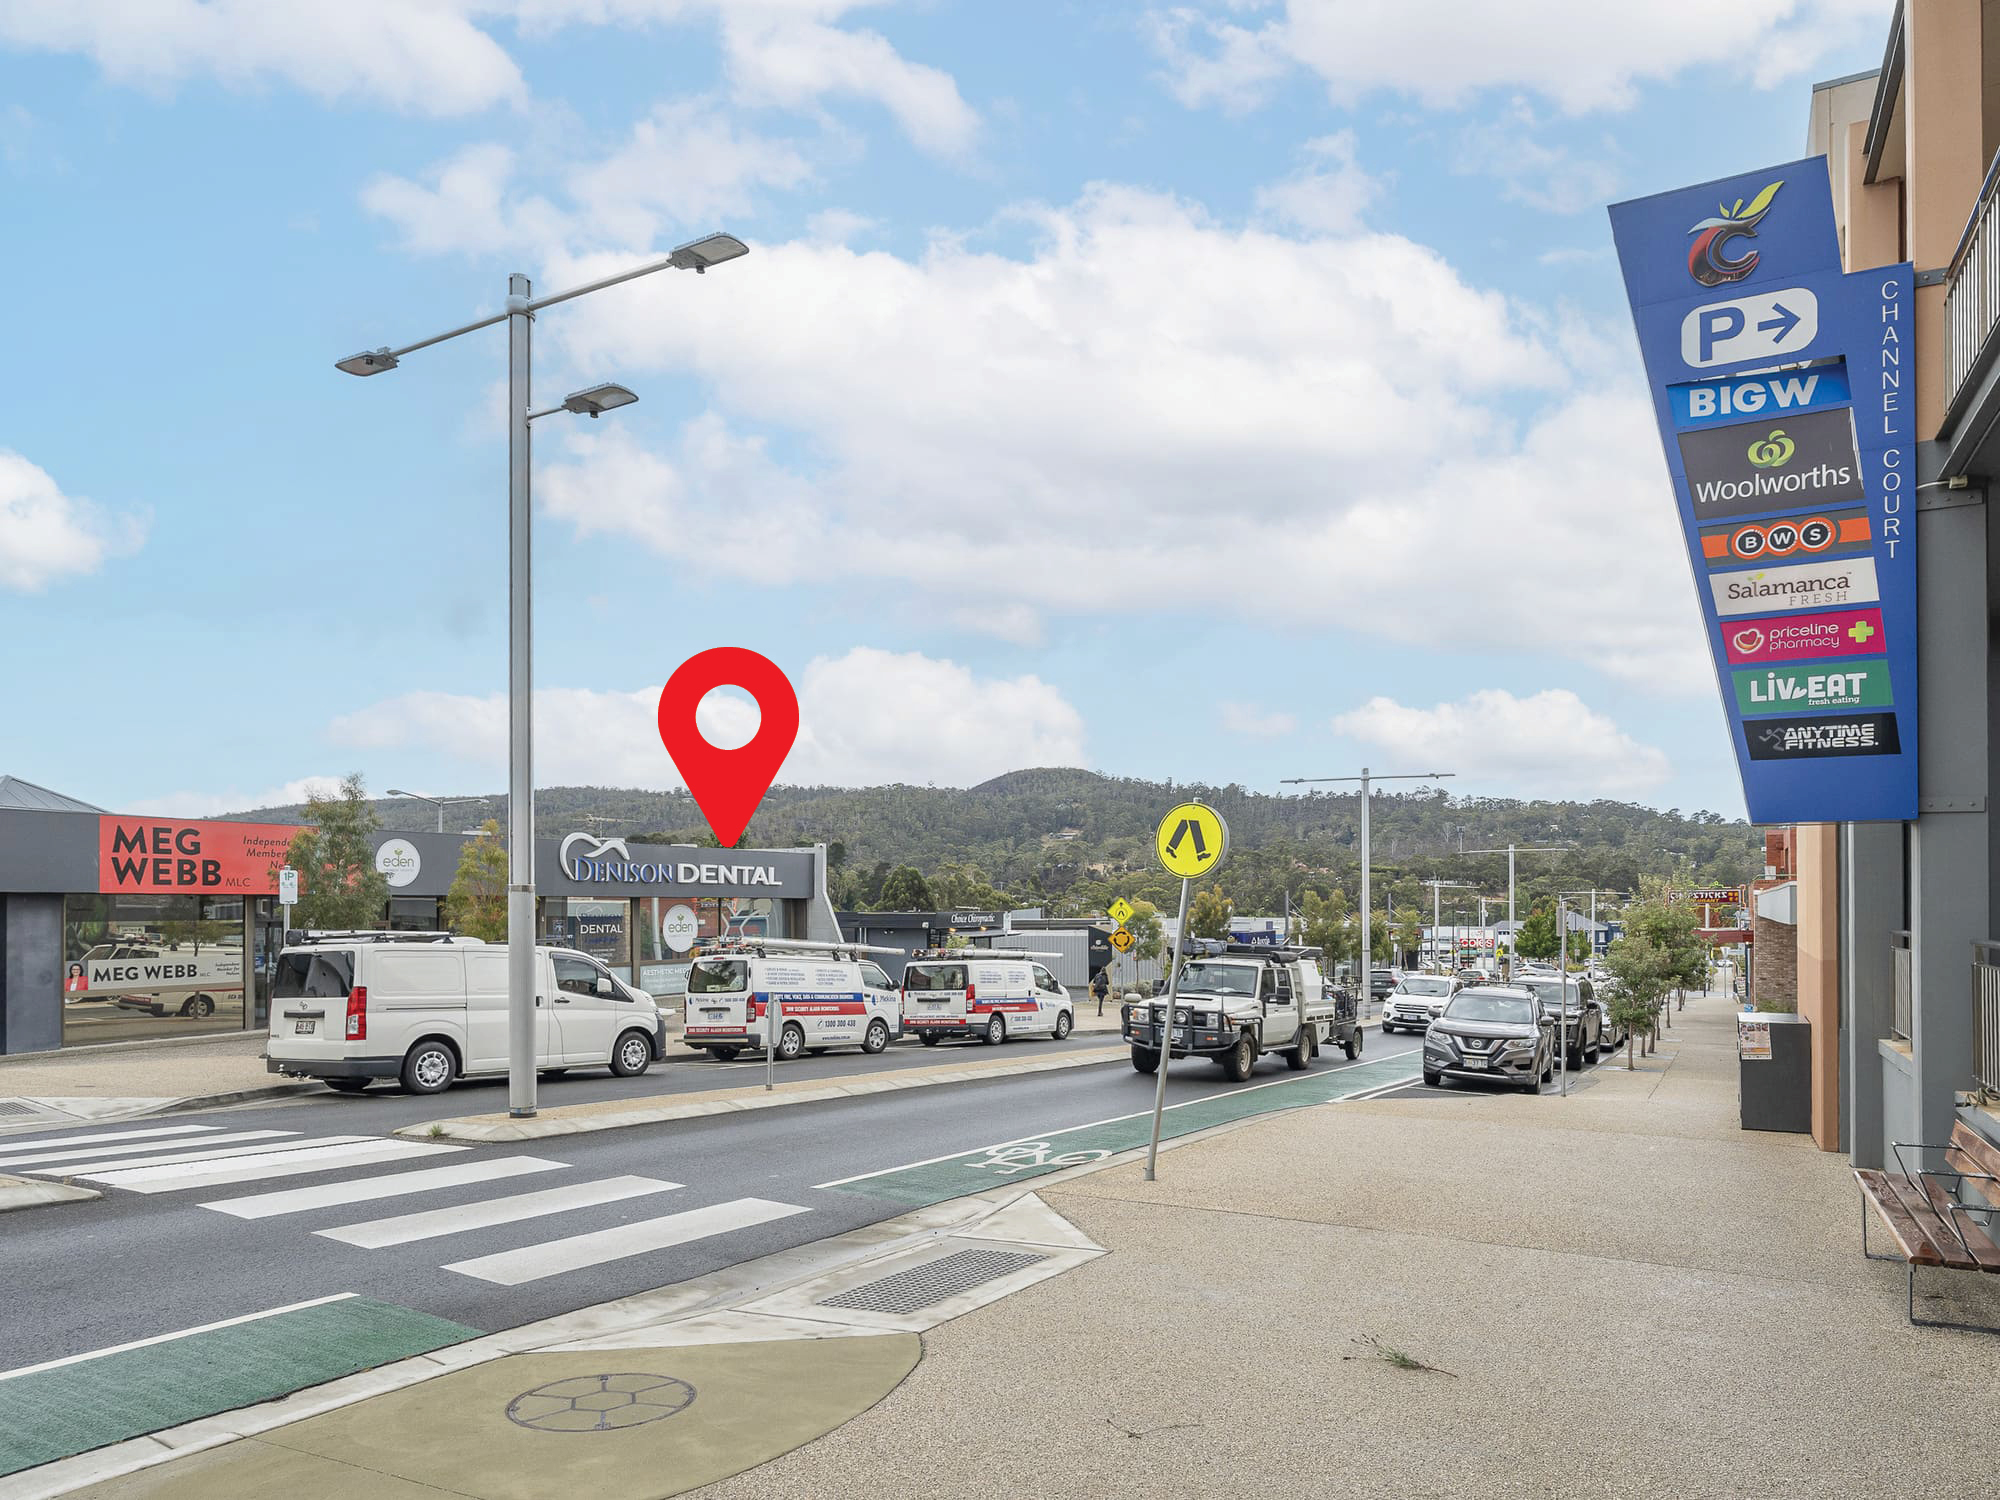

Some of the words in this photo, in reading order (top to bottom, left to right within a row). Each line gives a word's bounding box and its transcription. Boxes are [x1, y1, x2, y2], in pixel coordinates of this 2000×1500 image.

[1699, 307, 1745, 362] P
[1881, 280, 1899, 434] CHANNEL
[1696, 464, 1850, 503] Woolworths
[1883, 449, 1901, 559] COURT
[1743, 527, 1823, 551] BWS
[1728, 575, 1850, 600] Salamanca
[1789, 591, 1847, 606] FRESH
[1770, 624, 1839, 641] priceline
[1770, 636, 1839, 652] pharmacy
[1808, 698, 1831, 706] fresh
[1832, 696, 1860, 705] eating
[1784, 723, 1875, 740] ANYTIME
[112, 825, 201, 856] MEG
[383, 856, 415, 868] eden
[111, 856, 222, 886] WEBB
[225, 878, 251, 888] MLC
[677, 863, 783, 886] DENTAL
[580, 924, 624, 934] DENTAL
[668, 920, 694, 933] eden
[93, 966, 139, 982] MEG
[144, 964, 198, 979] WEBB
[825, 1020, 836, 1028] 1300
